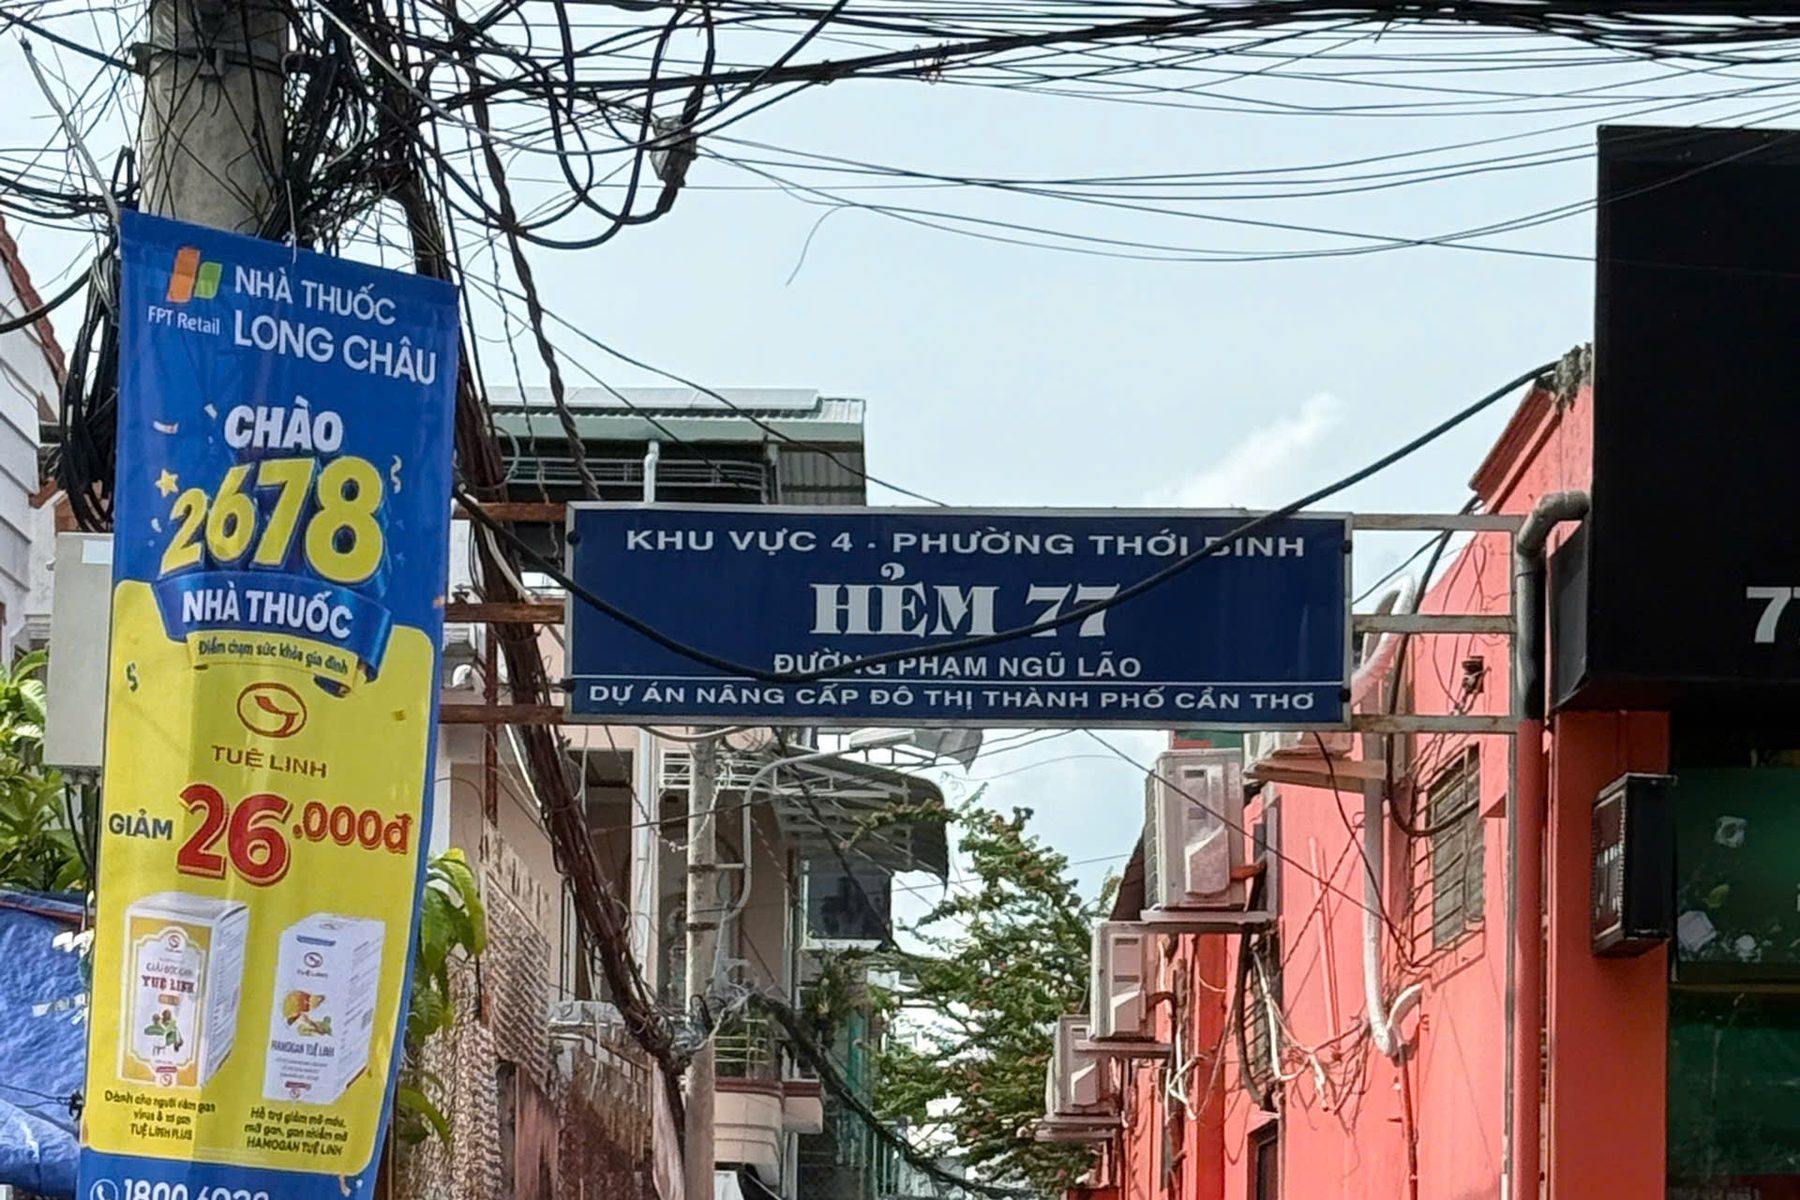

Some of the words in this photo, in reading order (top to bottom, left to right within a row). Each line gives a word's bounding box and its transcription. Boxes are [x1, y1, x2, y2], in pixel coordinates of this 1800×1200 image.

[147, 306, 173, 325] FPT
[177, 312, 221, 336] Retail
[234, 266, 293, 304] NHÀ
[301, 283, 397, 326] THUỐC
[234, 310, 334, 363] LONG
[343, 335, 437, 386] CHÂU
[224, 395, 344, 452] CHÀO
[159, 455, 384, 584] 2678
[626, 530, 714, 551] KHU
[729, 527, 817, 556] VỰC
[831, 532, 853, 552] 4
[893, 526, 1074, 555] PHƯỜNG
[1089, 528, 1188, 556] THỚI
[182, 581, 240, 623] NHÀ
[246, 590, 353, 639] THUỐC
[809, 562, 1000, 637] HẺM
[1026, 583, 1121, 637] 77
[1746, 586, 1800, 643] 7
[899, 655, 987, 679] PHẠM
[1000, 651, 1066, 678] NGŨ
[1078, 651, 1141, 678] LÃO
[589, 684, 634, 706] DỰ
[641, 682, 685, 703] ÁN
[696, 684, 785, 705] NÂNG
[795, 682, 859, 705] CẤP
[870, 685, 914, 706] ĐÔ
[924, 690, 973, 711] THỊ
[982, 687, 1089, 708] THÀNH
[1100, 686, 1167, 710] PHỐ
[1174, 685, 1240, 710] CẦN
[1250, 692, 1315, 710] THƠ
[211, 745, 264, 772] TUỆ
[269, 755, 328, 779] LINH
[108, 809, 173, 841] GIẢM
